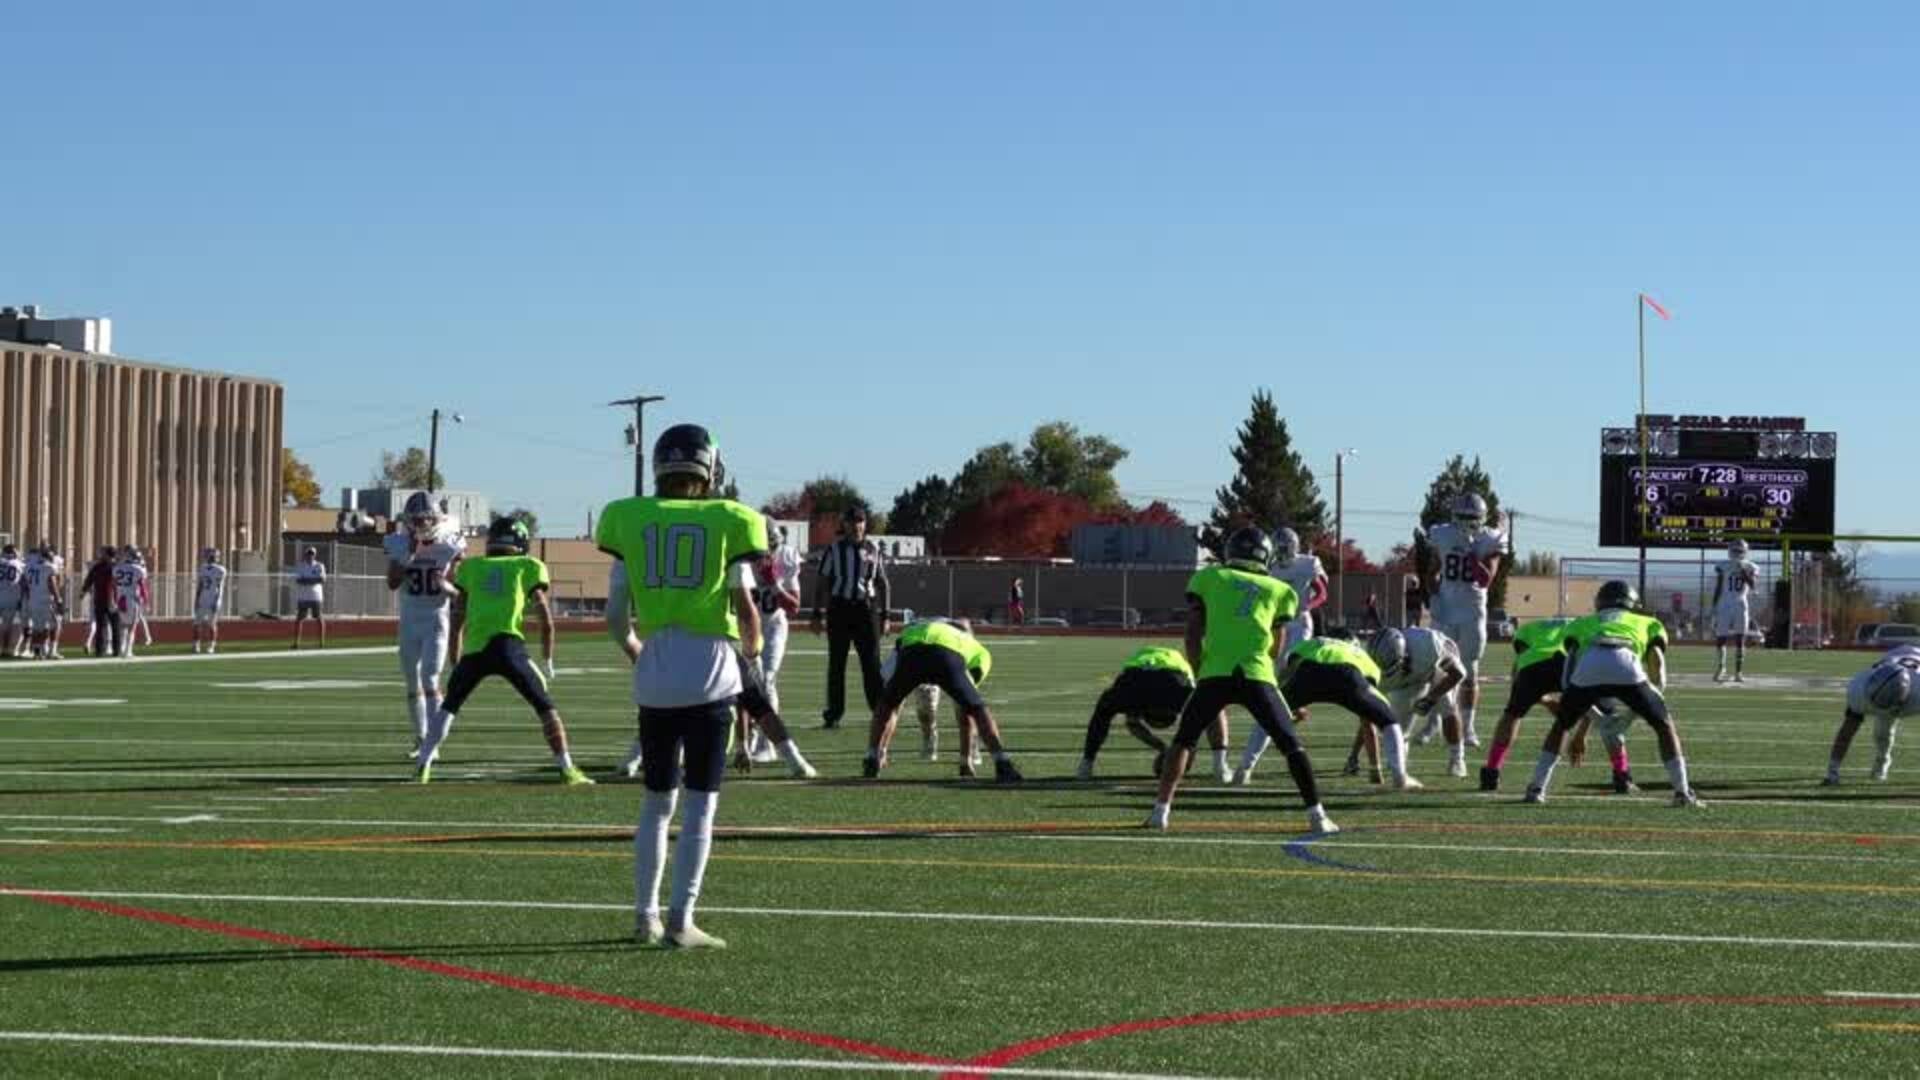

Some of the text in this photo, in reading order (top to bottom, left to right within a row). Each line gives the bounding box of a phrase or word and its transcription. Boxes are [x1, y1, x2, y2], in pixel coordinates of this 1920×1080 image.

[1699, 467, 1737, 484] 7:28
[1646, 485, 1659, 502] 6
[1766, 488, 1792, 505] 30
[642, 522, 707, 590] 10
[115, 569, 134, 587] 23
[407, 567, 442, 596] 30
[1727, 575, 1745, 593] 10
[1231, 580, 1260, 618] 7
